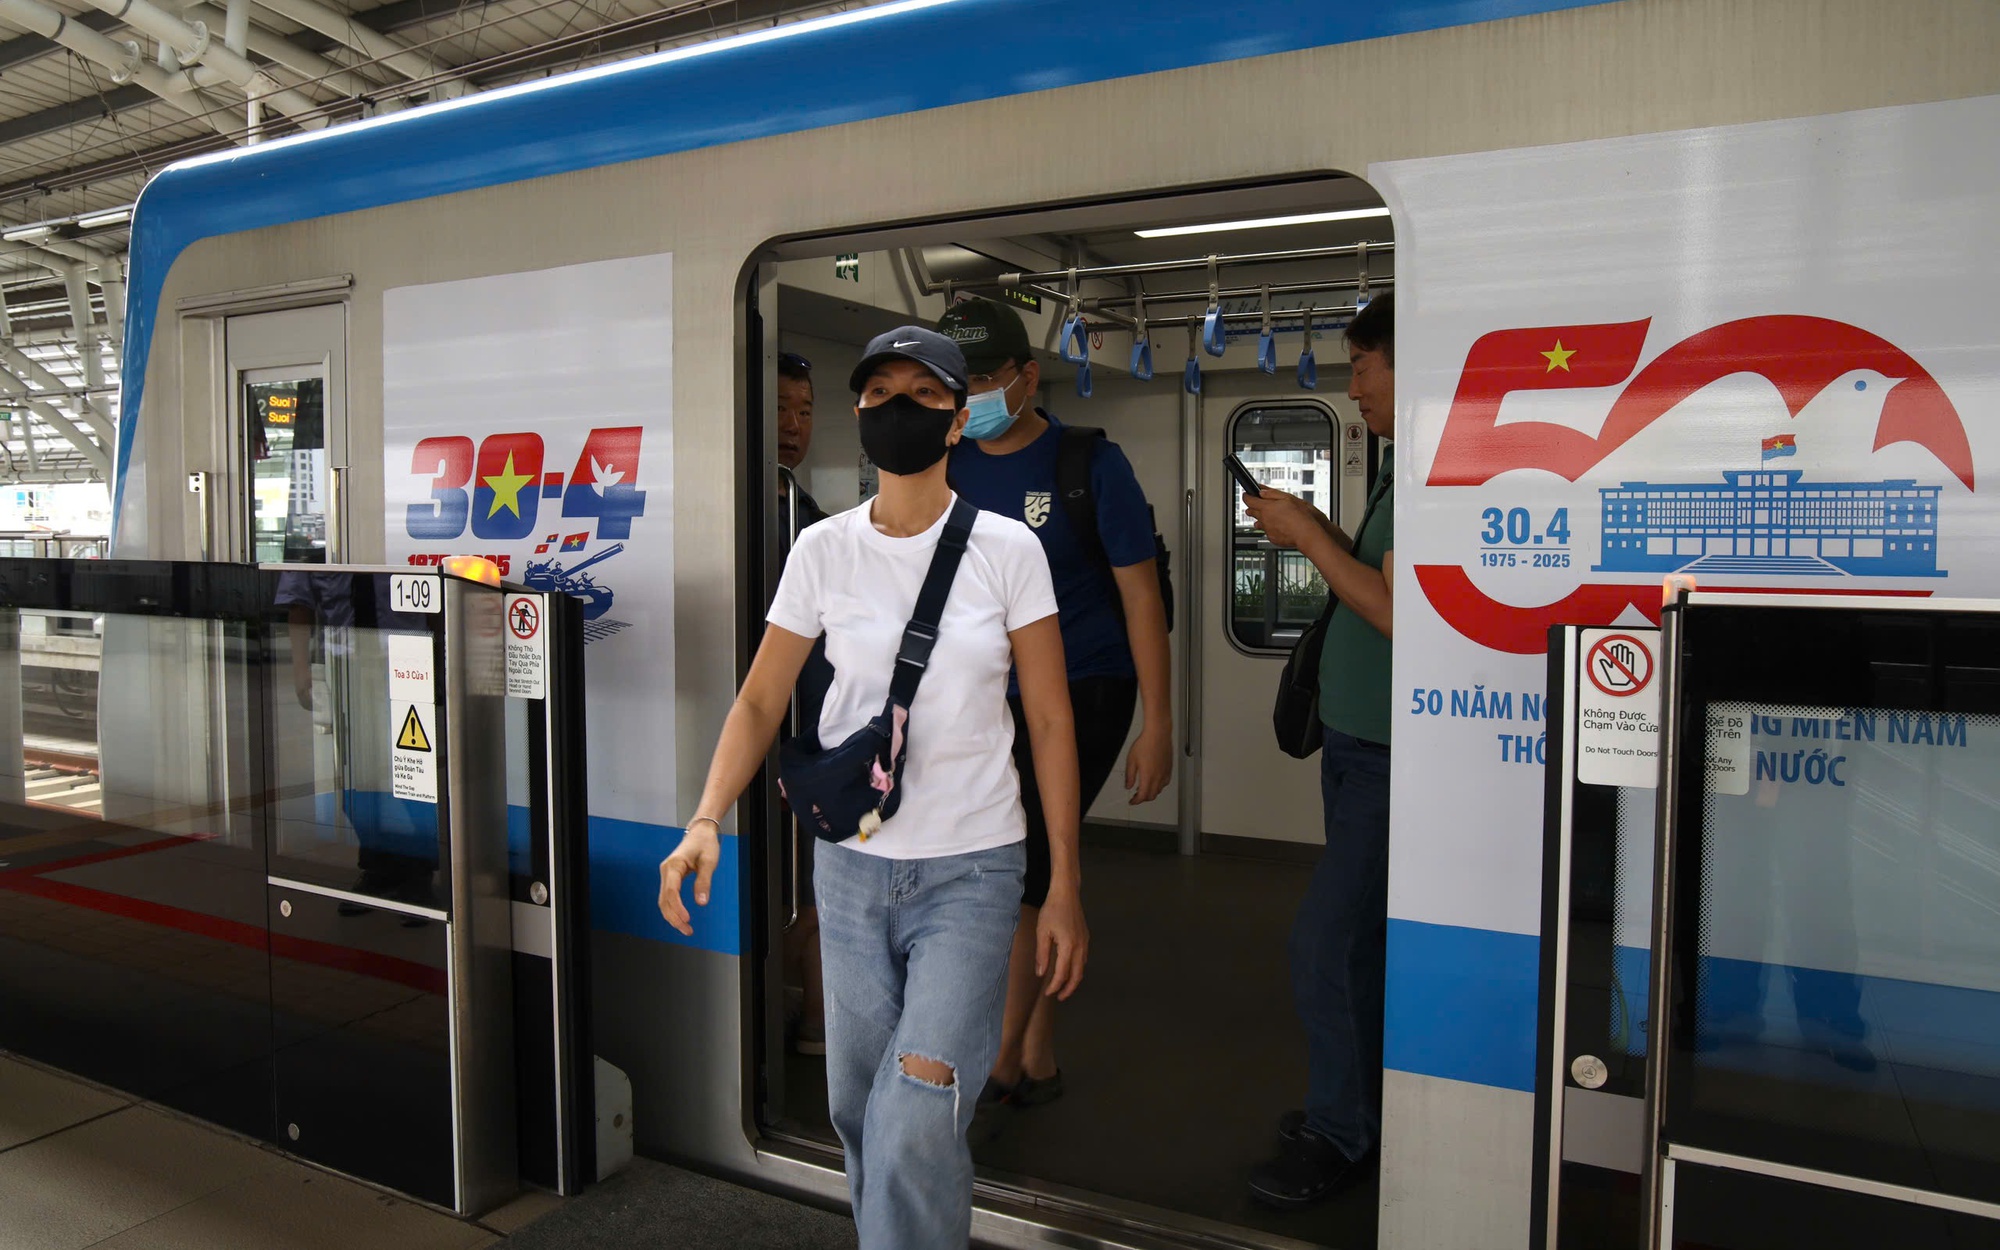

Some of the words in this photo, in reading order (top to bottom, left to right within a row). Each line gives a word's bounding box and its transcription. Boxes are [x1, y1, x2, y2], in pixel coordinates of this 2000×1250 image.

[269, 395, 291, 407] Suoi
[268, 411, 290, 423] Suoi
[406, 426, 646, 539] 30-4
[1481, 507, 1571, 545] 30.4
[1480, 553, 1516, 567] 1975
[1532, 553, 1570, 568] 2025
[397, 579, 430, 608] 1-09
[394, 669, 405, 679] Toa
[406, 670, 411, 679] 3
[1411, 688, 1443, 716] 50
[1451, 684, 1513, 720] NĂM
[1887, 710, 1968, 747] NAM
[1583, 708, 1616, 721] Không
[1619, 710, 1646, 722] Được
[1583, 719, 1613, 731] Chạm
[1616, 721, 1636, 731] Vào
[1638, 723, 1659, 733] Cửa
[1716, 728, 1742, 739] Trên
[1597, 747, 1610, 755] Not
[1612, 748, 1635, 756] Touch
[1636, 749, 1658, 757] Doors
[1717, 757, 1733, 766] Any
[1756, 749, 1847, 787] NƯỚC
